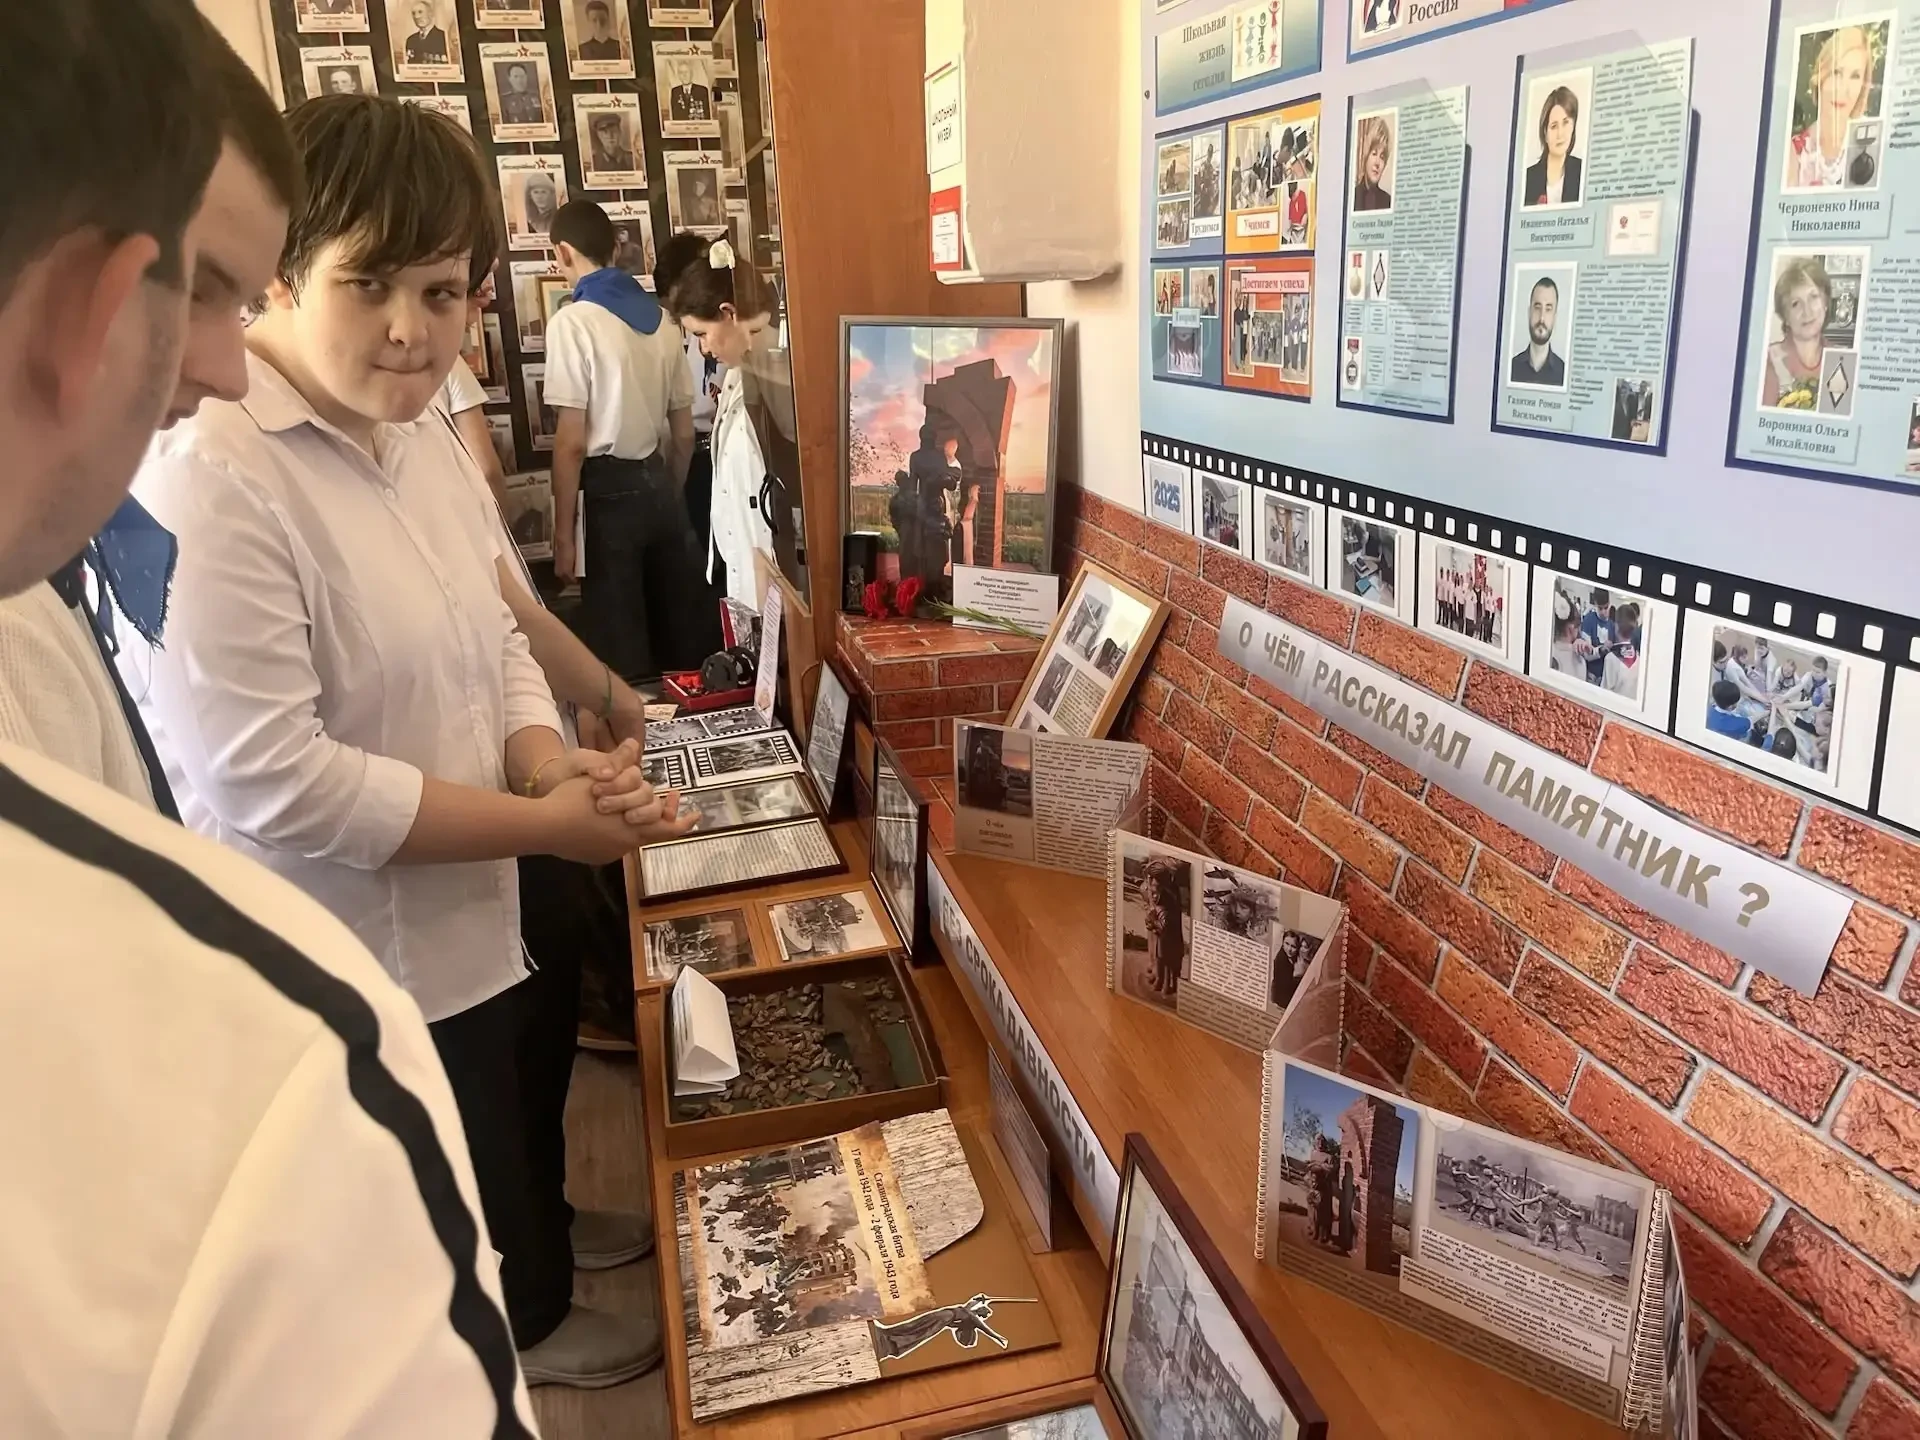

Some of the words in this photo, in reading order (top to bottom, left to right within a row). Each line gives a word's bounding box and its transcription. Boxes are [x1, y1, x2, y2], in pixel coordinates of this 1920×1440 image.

[1408, 0, 1459, 24] Россия
[1183, 15, 1227, 43] Школьная
[1198, 43, 1226, 64] жизнь
[1193, 70, 1226, 91] сегодня
[1778, 201, 1846, 216] Червоненко
[1849, 199, 1880, 212] Нина
[1244, 219, 1270, 231] Учимся
[1557, 216, 1589, 226] Наталья
[1791, 219, 1861, 231] Николаевна
[1530, 232, 1575, 243] Викторовна
[1242, 277, 1279, 289] Достигаем
[1279, 278, 1305, 291] успеха
[1538, 398, 1561, 409] Роман
[1512, 409, 1552, 422] Васильевич
[1758, 417, 1812, 433] Воронина
[1815, 423, 1849, 437] Ольга
[1765, 435, 1836, 454] Михайловна
[1154, 479, 1180, 513] 2025
[1238, 621, 1253, 648] О
[1264, 633, 1306, 679] ЧЁМ
[1312, 659, 1471, 769] РАССКАЗАЛ
[1482, 750, 1721, 909] ПАМЯТНИК
[1736, 882, 1770, 928] ?
[942, 895, 963, 947] БЕЗ
[965, 934, 1006, 1027] СРОКА
[1006, 1005, 1097, 1188] ДАВНОСТИ
[851, 1147, 861, 1158] 17
[854, 1157, 866, 1177] июля
[859, 1176, 873, 1195] 1942
[864, 1195, 875, 1212] года
[873, 1171, 897, 1234] Сталинградская
[892, 1234, 906, 1259] битва
[873, 1224, 889, 1258] февраля
[882, 1258, 896, 1280] 1943
[888, 1279, 900, 1300] года
